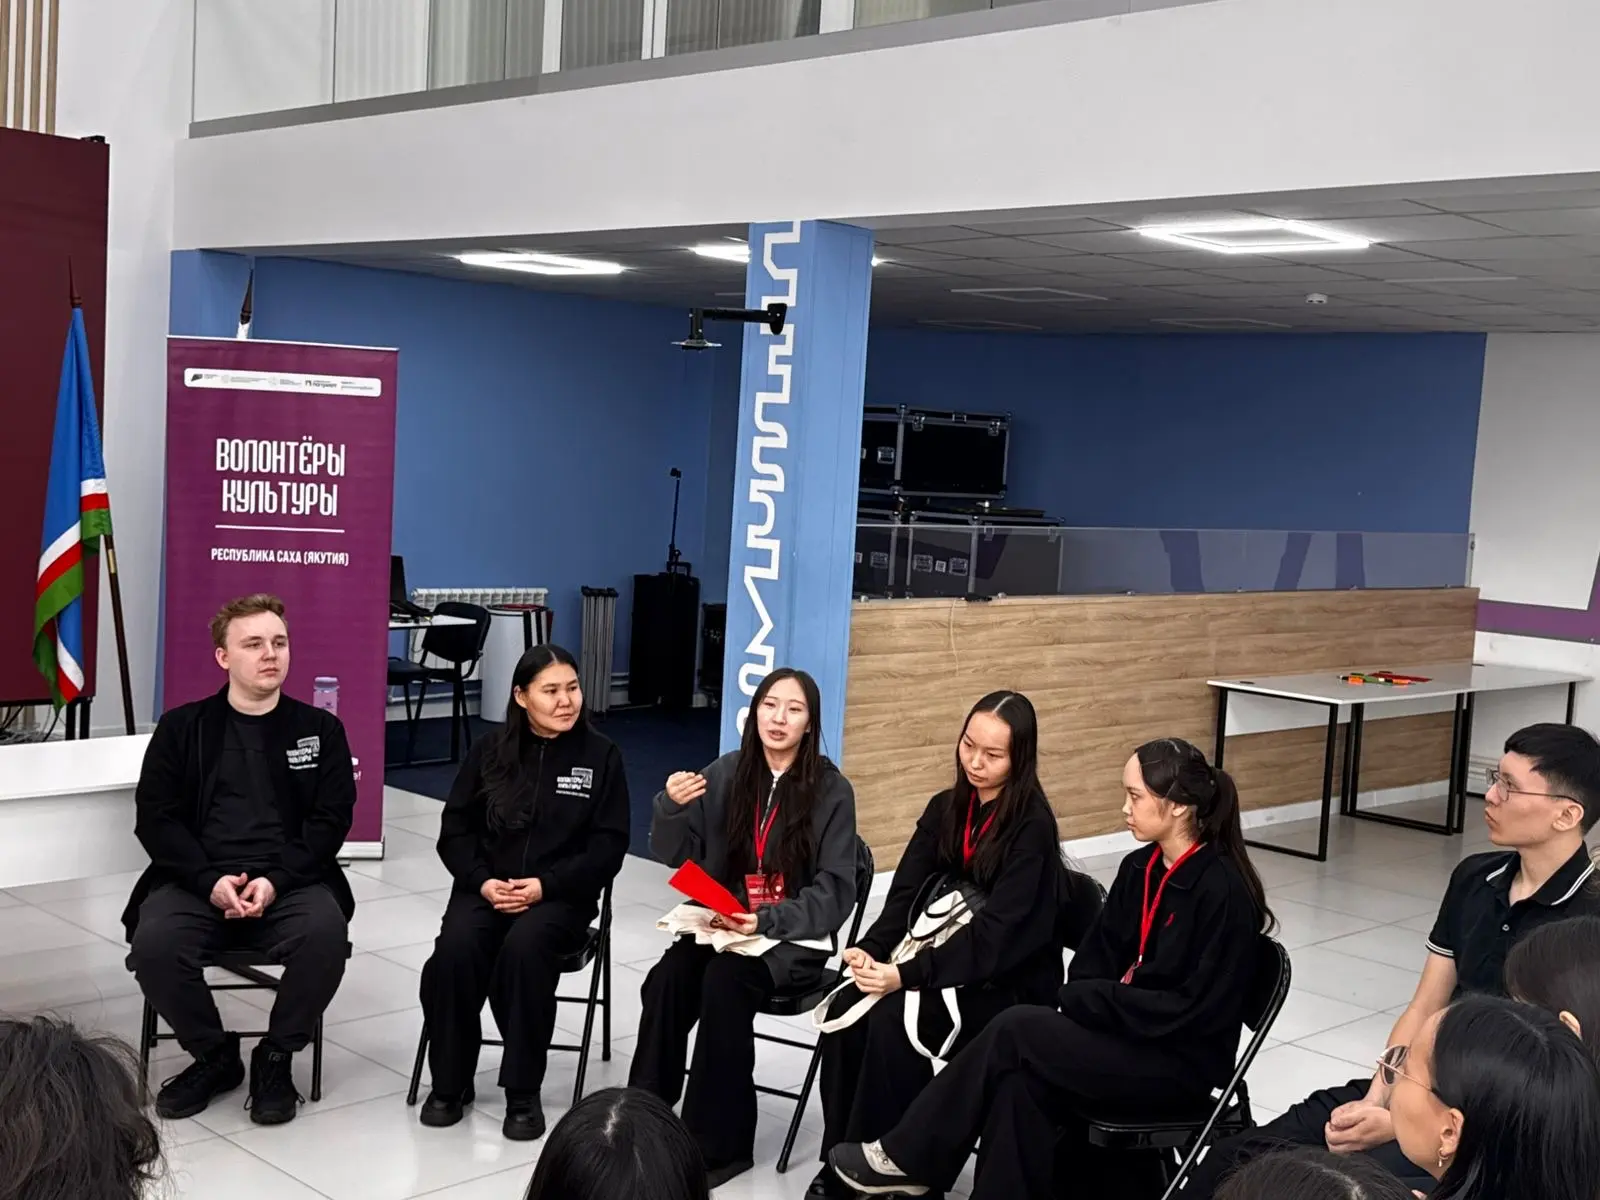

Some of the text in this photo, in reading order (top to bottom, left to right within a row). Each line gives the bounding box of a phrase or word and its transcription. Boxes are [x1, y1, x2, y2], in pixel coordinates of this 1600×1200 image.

[215, 435, 346, 477] ВОЛОНТЁРЫ
[222, 479, 338, 516] КУЛЬТУРЫ
[211, 547, 349, 567] РЕСПУБЛИКА САХА (ЯКУТИЯ)
